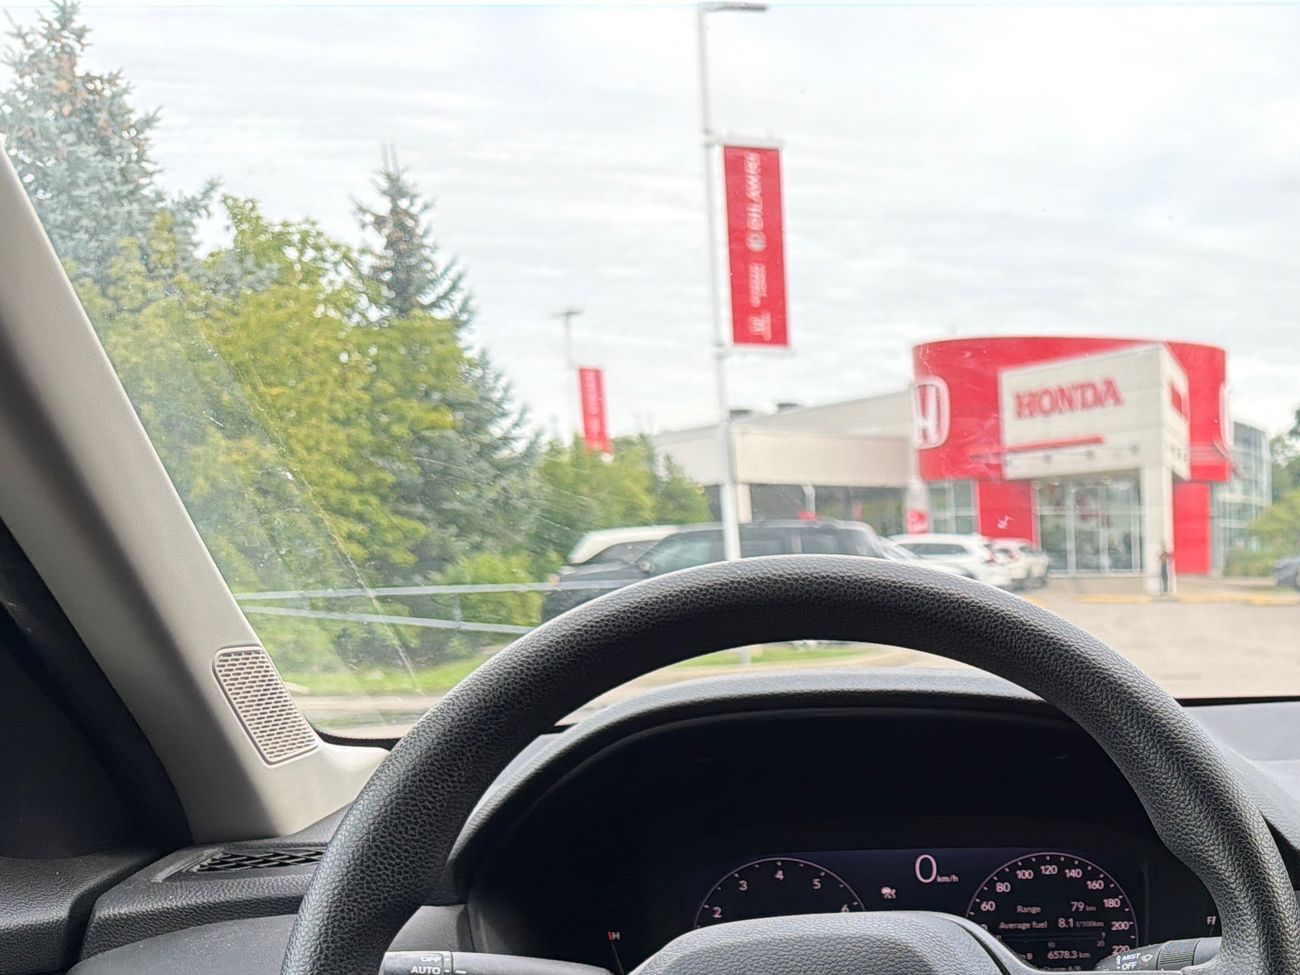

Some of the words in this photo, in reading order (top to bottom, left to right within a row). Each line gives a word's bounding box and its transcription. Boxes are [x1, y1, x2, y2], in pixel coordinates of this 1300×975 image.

[1016, 378, 1124, 418] HONDA
[915, 854, 937, 883] 0
[1040, 865, 1058, 875] 120
[1065, 868, 1083, 879] 140
[775, 869, 784, 880] 4
[1016, 869, 1034, 880] 100
[738, 880, 748, 891] 3
[812, 879, 821, 890] 5
[996, 881, 1011, 893] 80
[1086, 880, 1105, 890] 160
[980, 901, 996, 912] 60
[1070, 901, 1085, 912] 79
[1103, 897, 1121, 908] 180
[711, 906, 722, 918] 2
[1016, 905, 1042, 914] Range
[999, 921, 1031, 930] Average
[1032, 920, 1048, 929] fuel
[1058, 917, 1074, 929] 8.1
[1111, 921, 1130, 931] 200
[1047, 951, 1078, 960] 6578.3
[410, 966, 441, 975] AUTO
[1122, 961, 1138, 970] OFF
